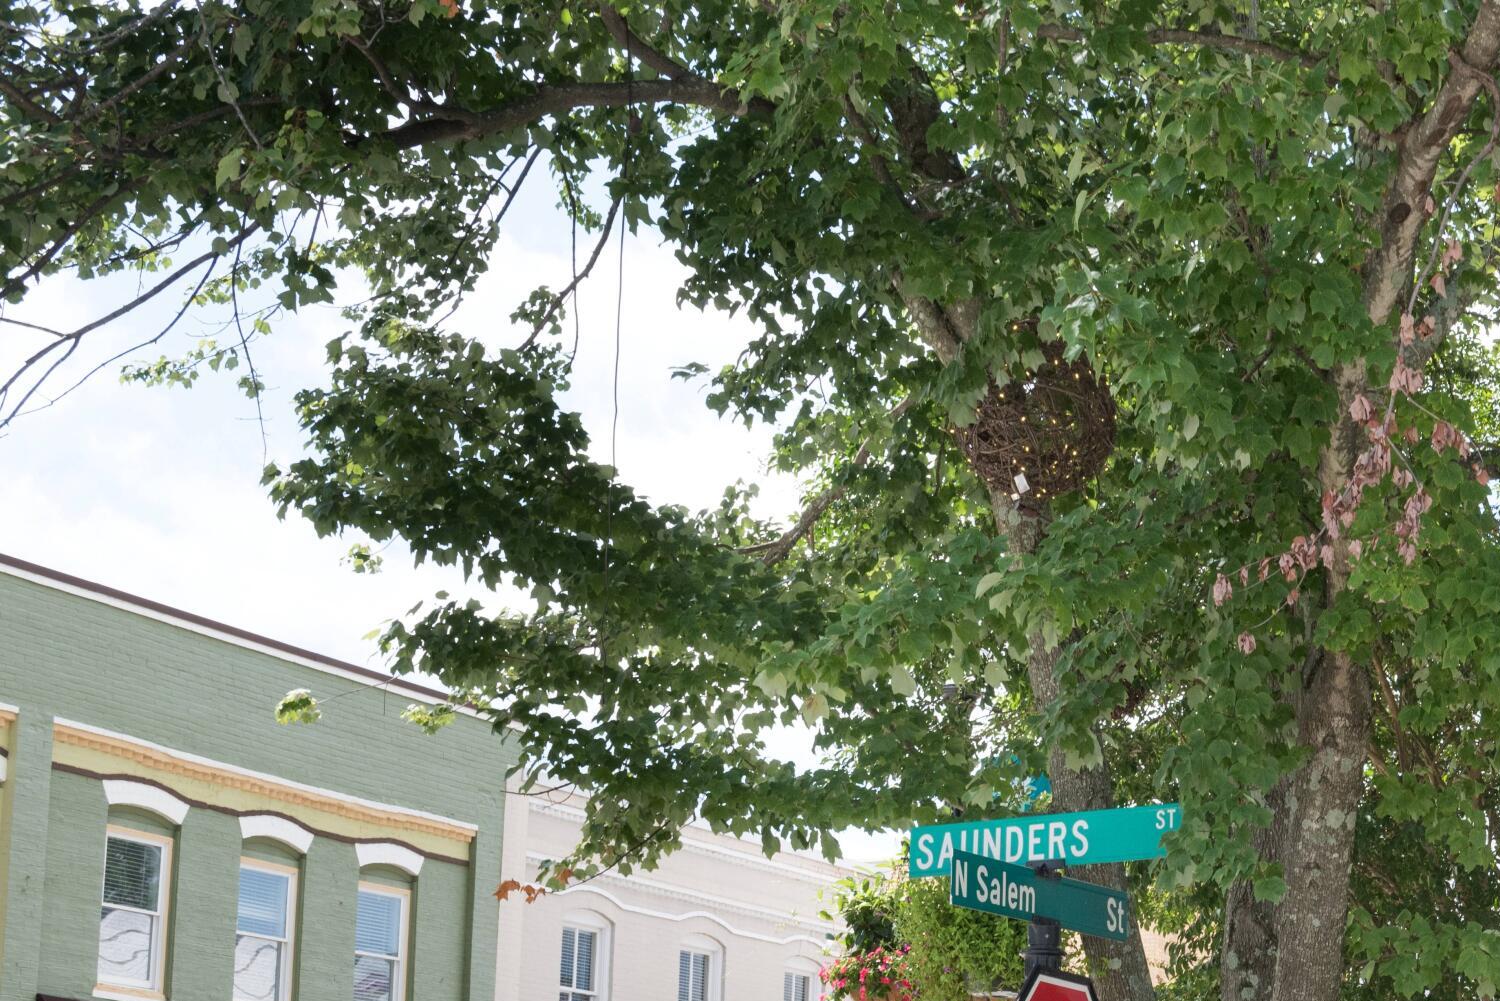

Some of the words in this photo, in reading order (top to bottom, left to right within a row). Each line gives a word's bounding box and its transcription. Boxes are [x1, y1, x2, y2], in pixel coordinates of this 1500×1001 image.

[1155, 808, 1177, 830] ST
[954, 859, 968, 899] N
[976, 864, 1036, 914] Salem
[1106, 896, 1125, 934] St
